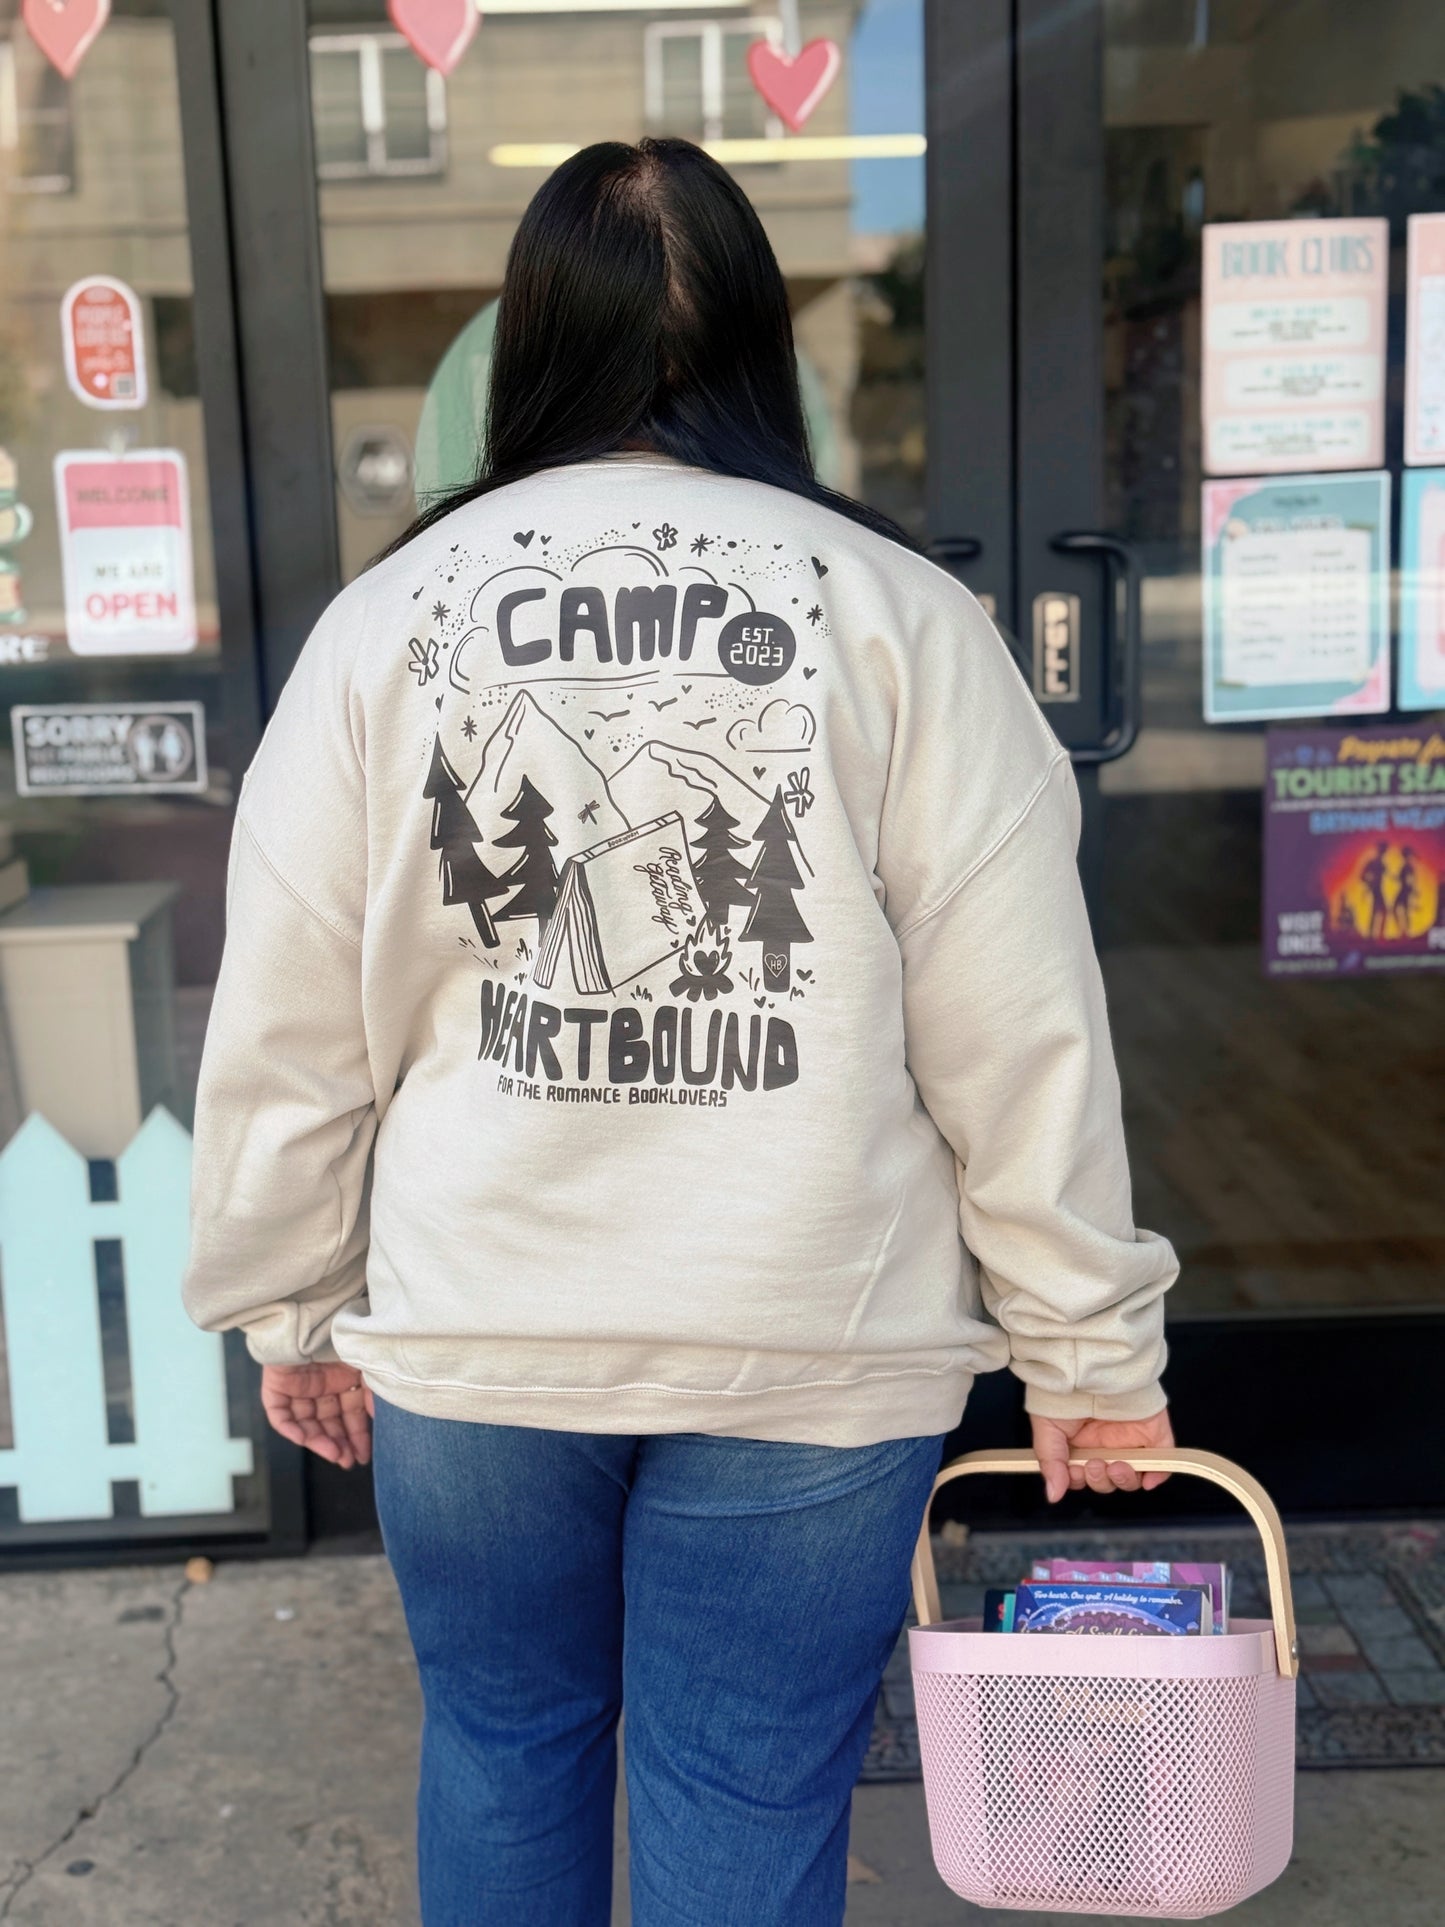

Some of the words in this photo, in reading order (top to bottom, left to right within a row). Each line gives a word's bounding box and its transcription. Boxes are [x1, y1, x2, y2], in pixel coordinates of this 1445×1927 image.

[86, 592, 178, 620] OPEN
[497, 583, 729, 667] CAMP
[741, 627, 776, 645] EST.
[730, 642, 784, 668] 2023
[25, 716, 134, 748] SORRY
[1272, 762, 1395, 800] TOURIST
[770, 957, 783, 970] HB
[477, 979, 799, 1092] HEARTBOUND
[497, 1075, 513, 1095] FOR
[517, 1080, 542, 1101] THE
[546, 1086, 622, 1105] ROMANCE
[628, 1087, 728, 1108] BOOKLOVERS
